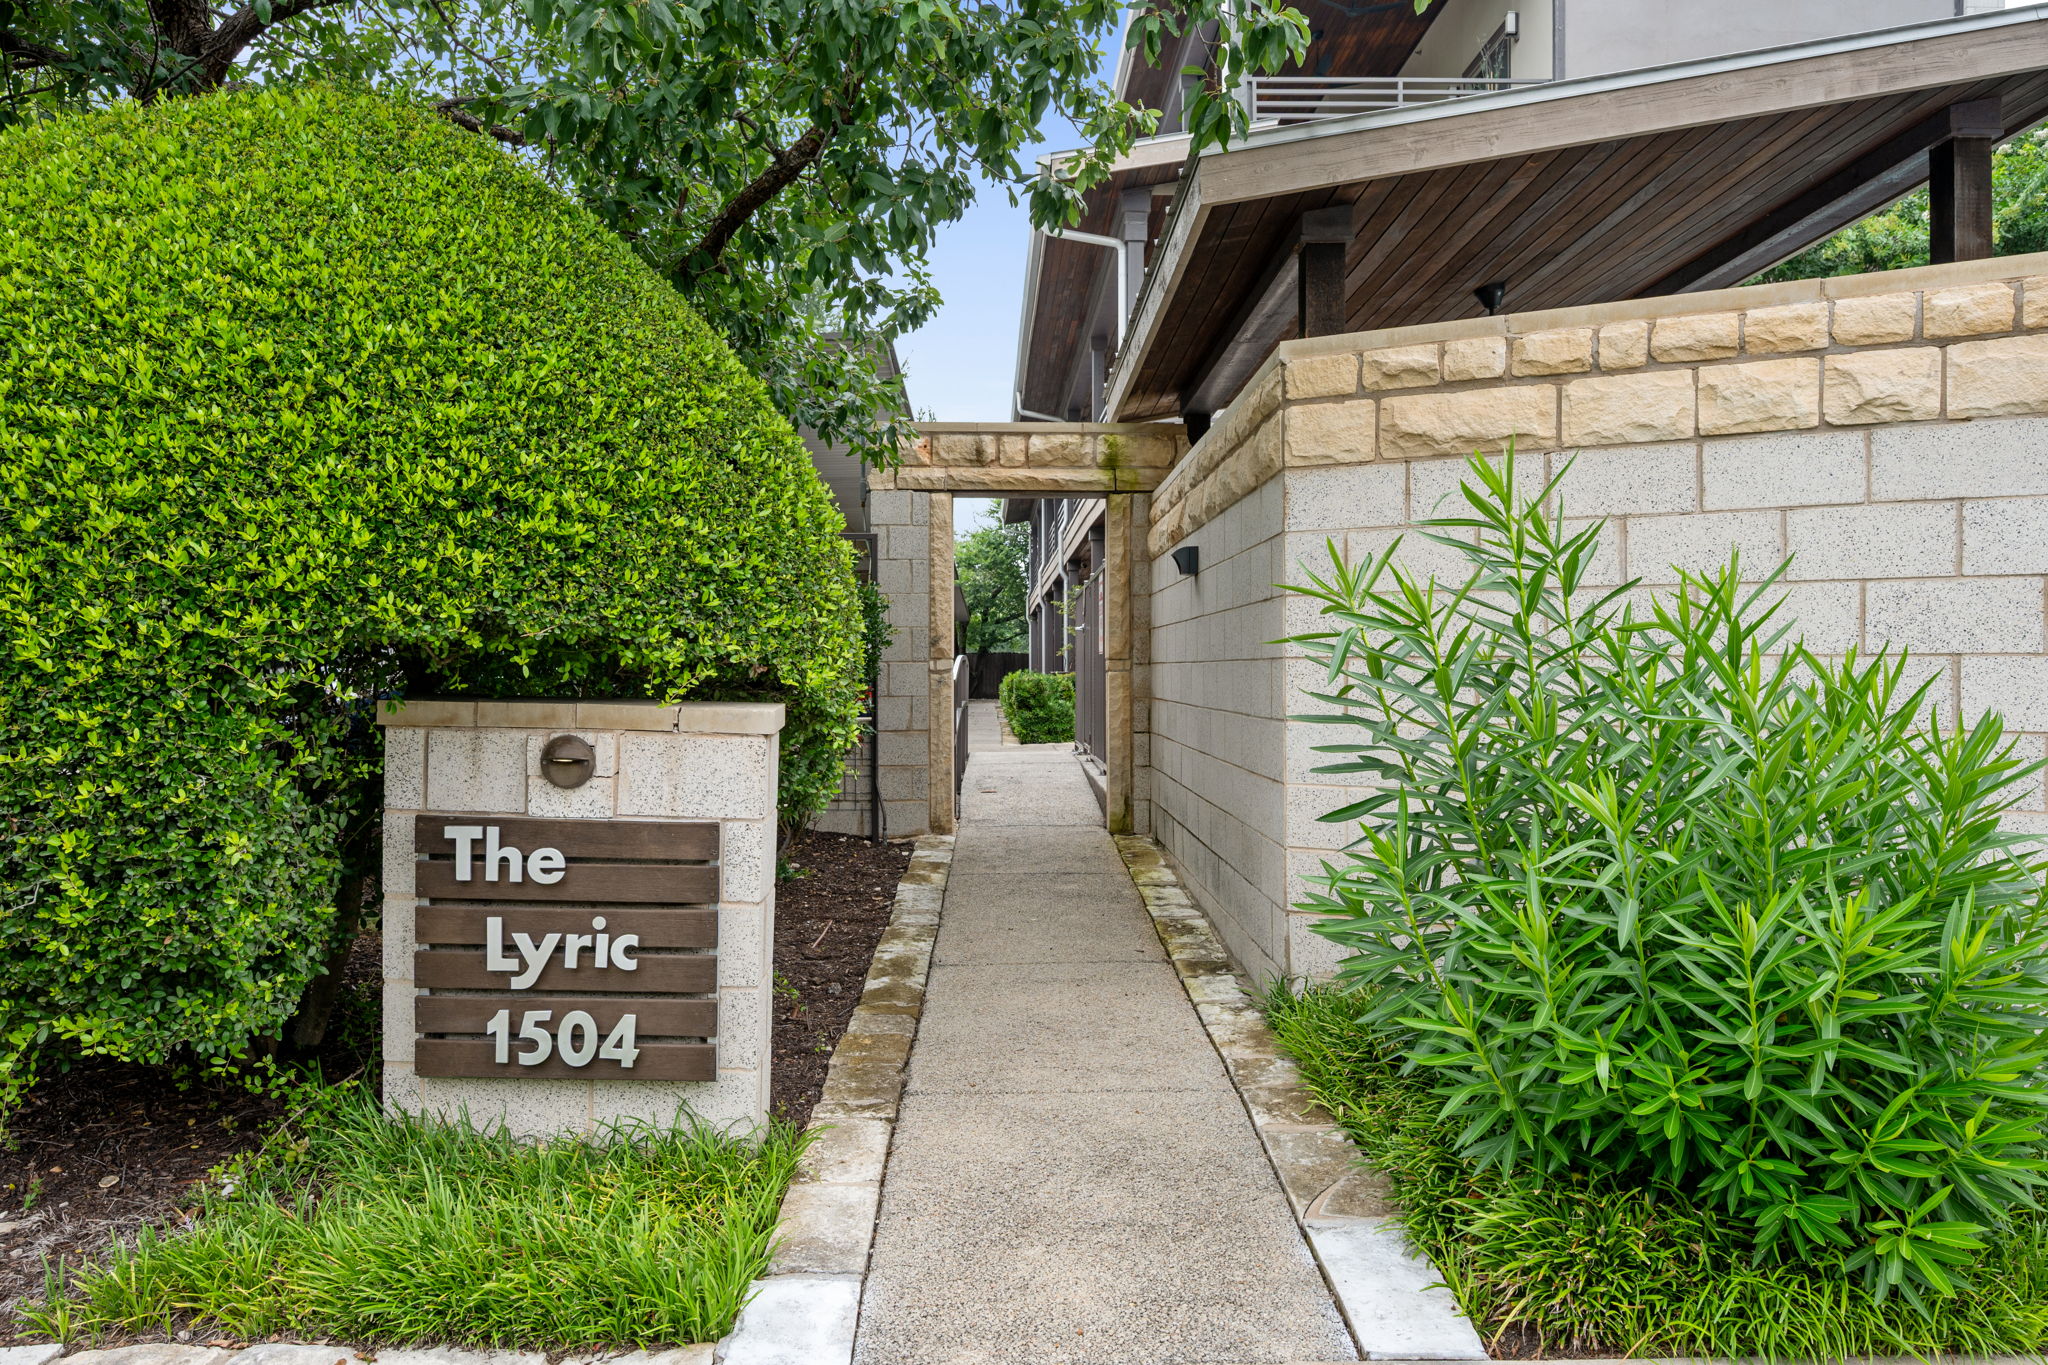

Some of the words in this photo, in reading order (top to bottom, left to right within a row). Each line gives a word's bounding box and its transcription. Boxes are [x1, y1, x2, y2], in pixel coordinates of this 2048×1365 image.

[444, 825, 566, 884] The
[486, 916, 639, 990] Lyric
[486, 1009, 640, 1068] 1504
